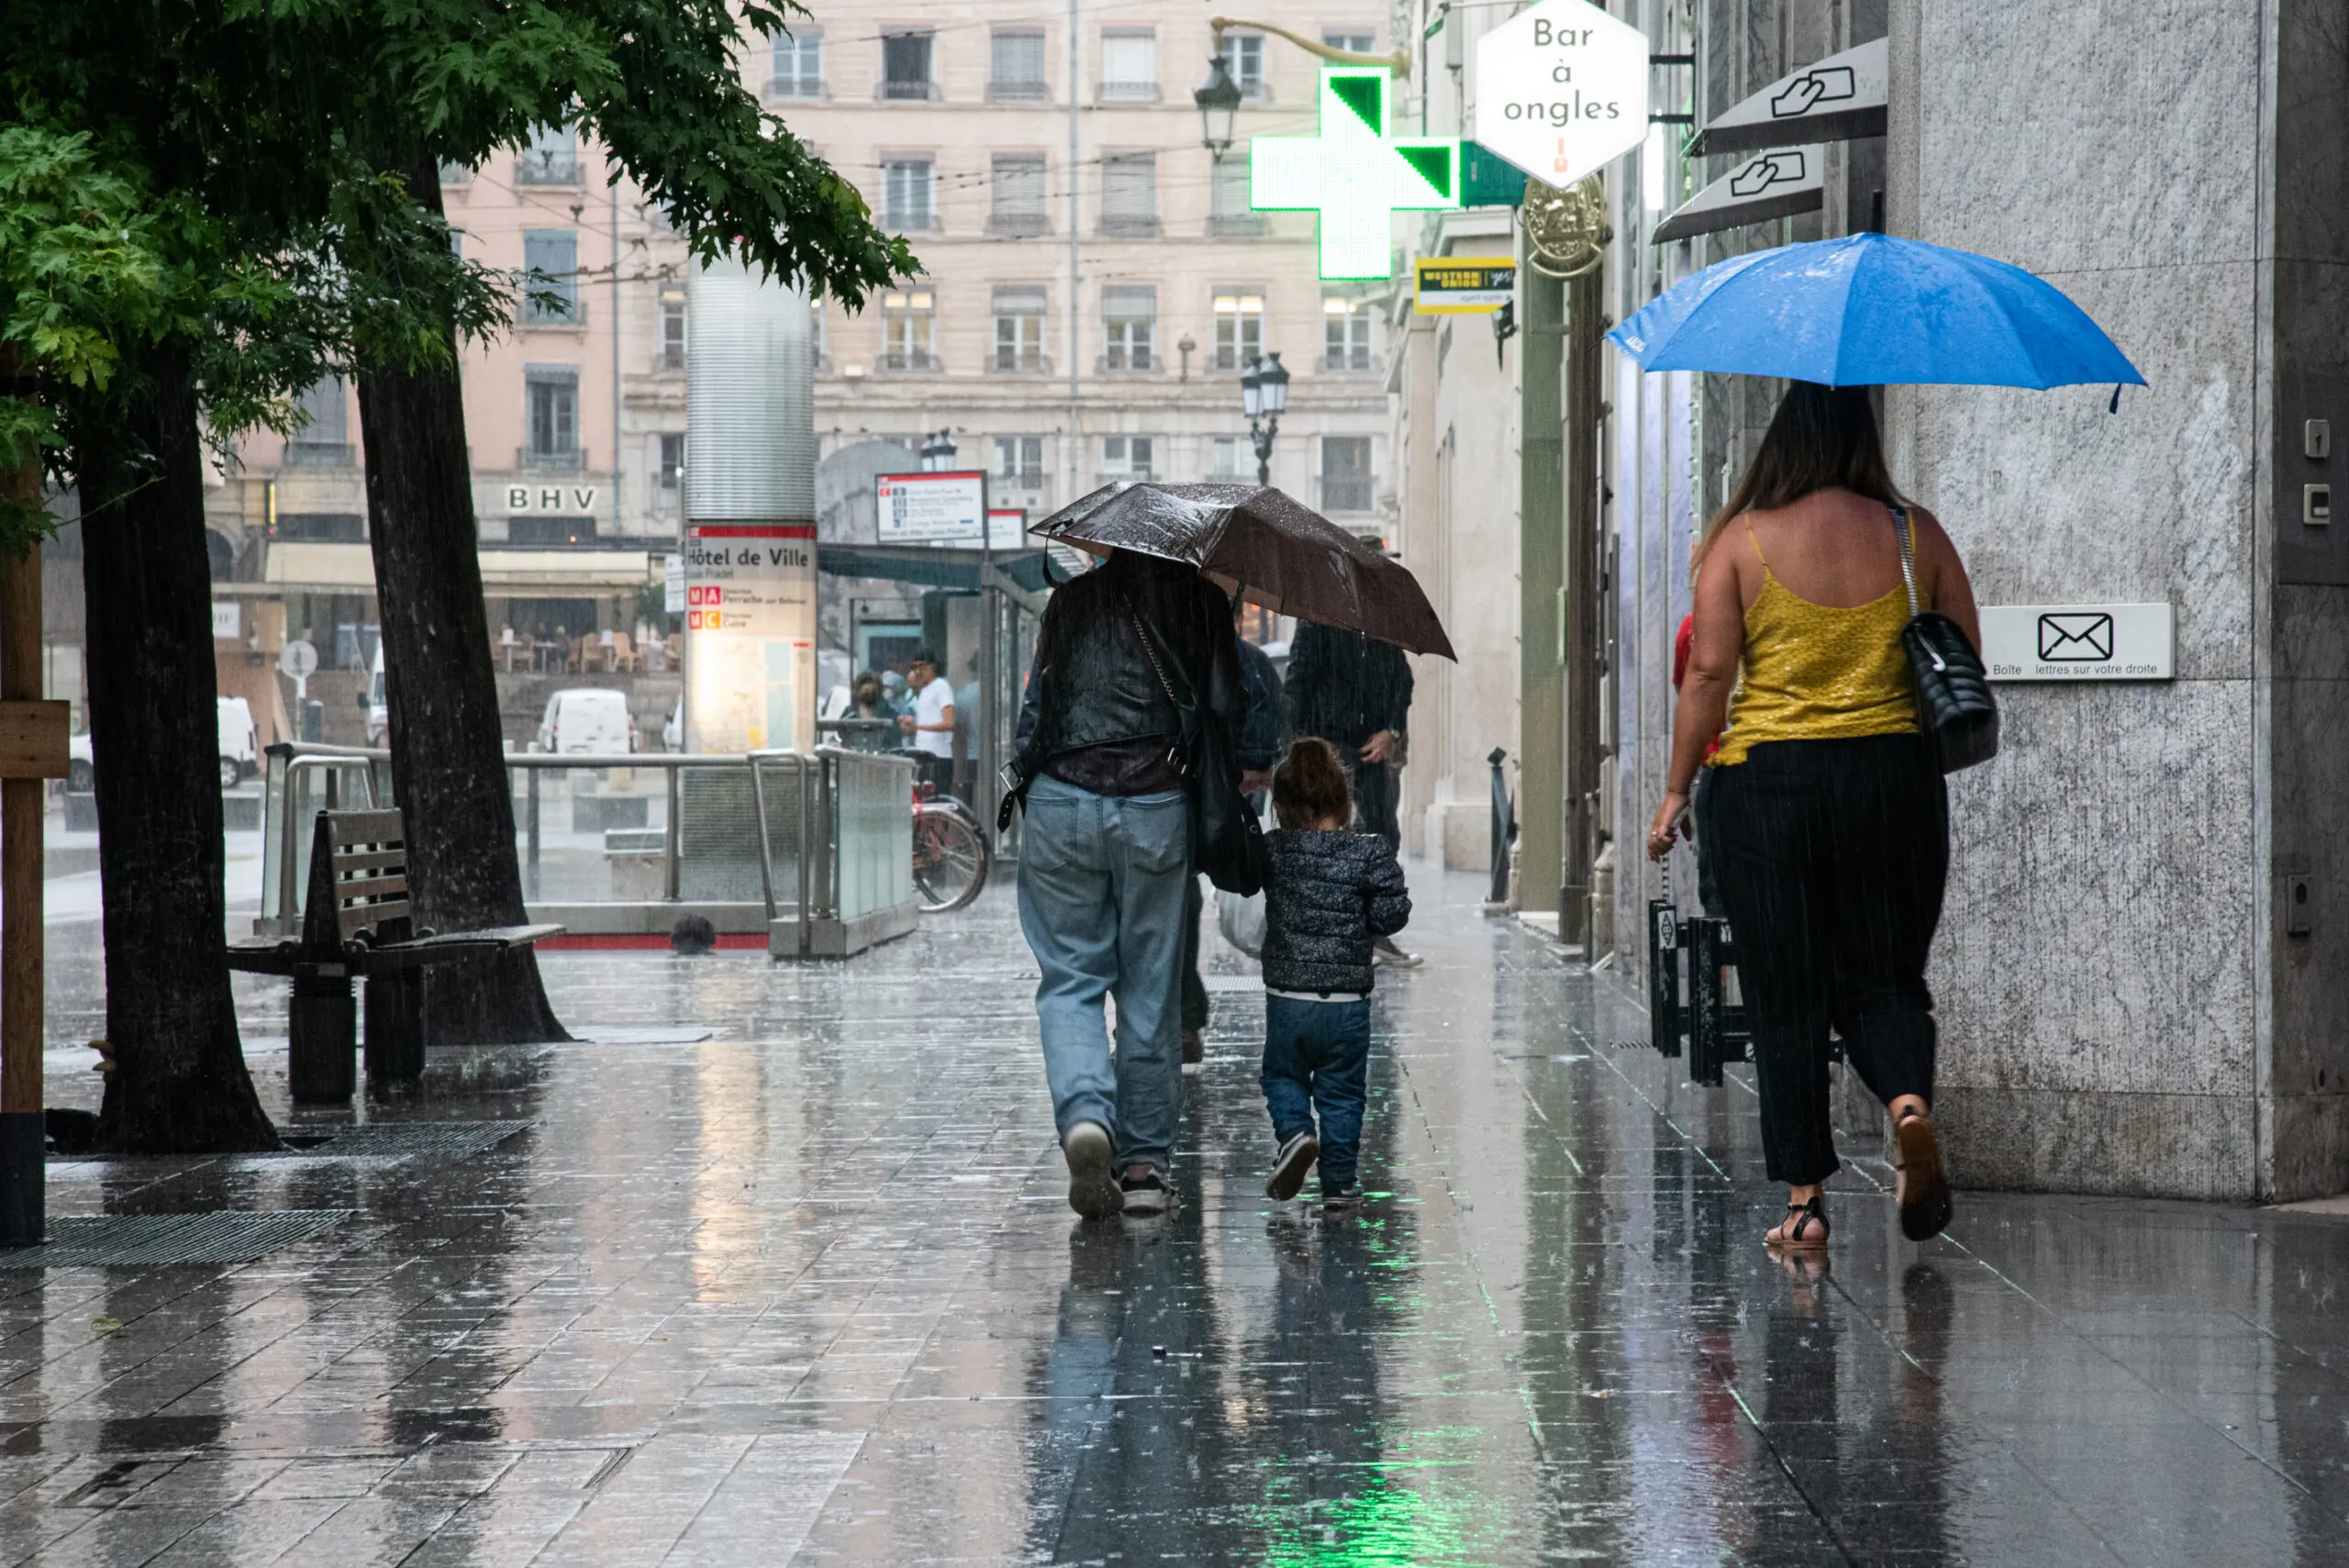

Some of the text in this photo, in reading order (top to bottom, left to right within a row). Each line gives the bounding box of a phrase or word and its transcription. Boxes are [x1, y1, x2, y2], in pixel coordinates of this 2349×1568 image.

[1534, 18, 1594, 47] Bar
[1552, 58, 1572, 83] à
[1504, 88, 1620, 128] ongles
[1424, 271, 1480, 281] WESTERN
[1442, 279, 1480, 288] UNION
[509, 488, 595, 509] BHV
[687, 548, 809, 566] Hôtel de Ville
[706, 588, 719, 604] A
[2035, 663, 2070, 675] lettres
[2073, 665, 2091, 674] sur
[2094, 663, 2122, 674] votre
[2125, 662, 2157, 674] droite
